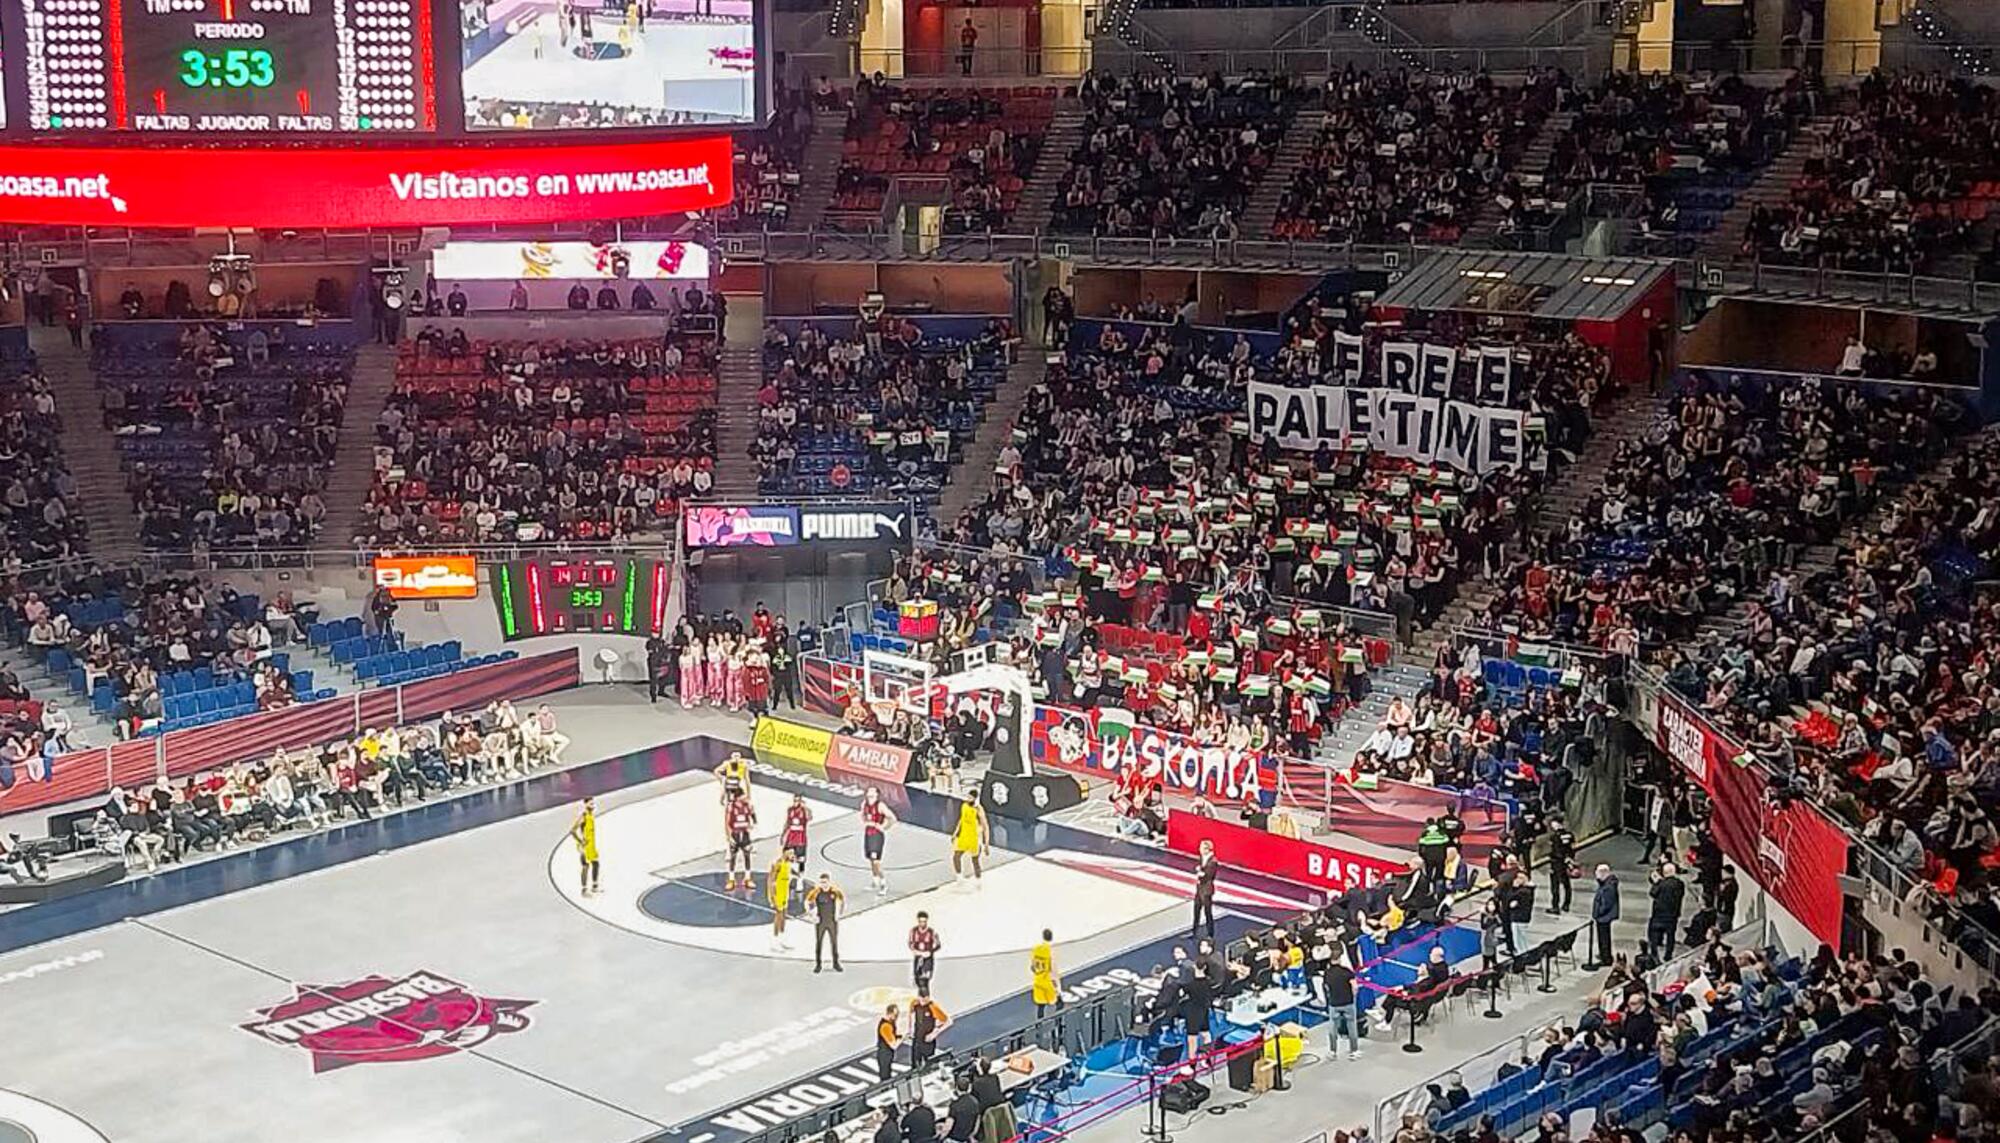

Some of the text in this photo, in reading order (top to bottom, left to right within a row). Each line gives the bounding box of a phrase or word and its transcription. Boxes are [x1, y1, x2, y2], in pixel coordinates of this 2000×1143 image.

[194, 23, 264, 38] PERIODO
[335, 28, 355, 43] 12
[182, 50, 275, 87] 3:53
[135, 115, 332, 131] FALTAS JUGADOR FALTAS
[536, 174, 569, 195] en
[575, 163, 708, 194] www.soasa.net
[801, 513, 880, 539] PUMA
[571, 590, 603, 606] 3:53
[848, 745, 900, 772] AMBAR
